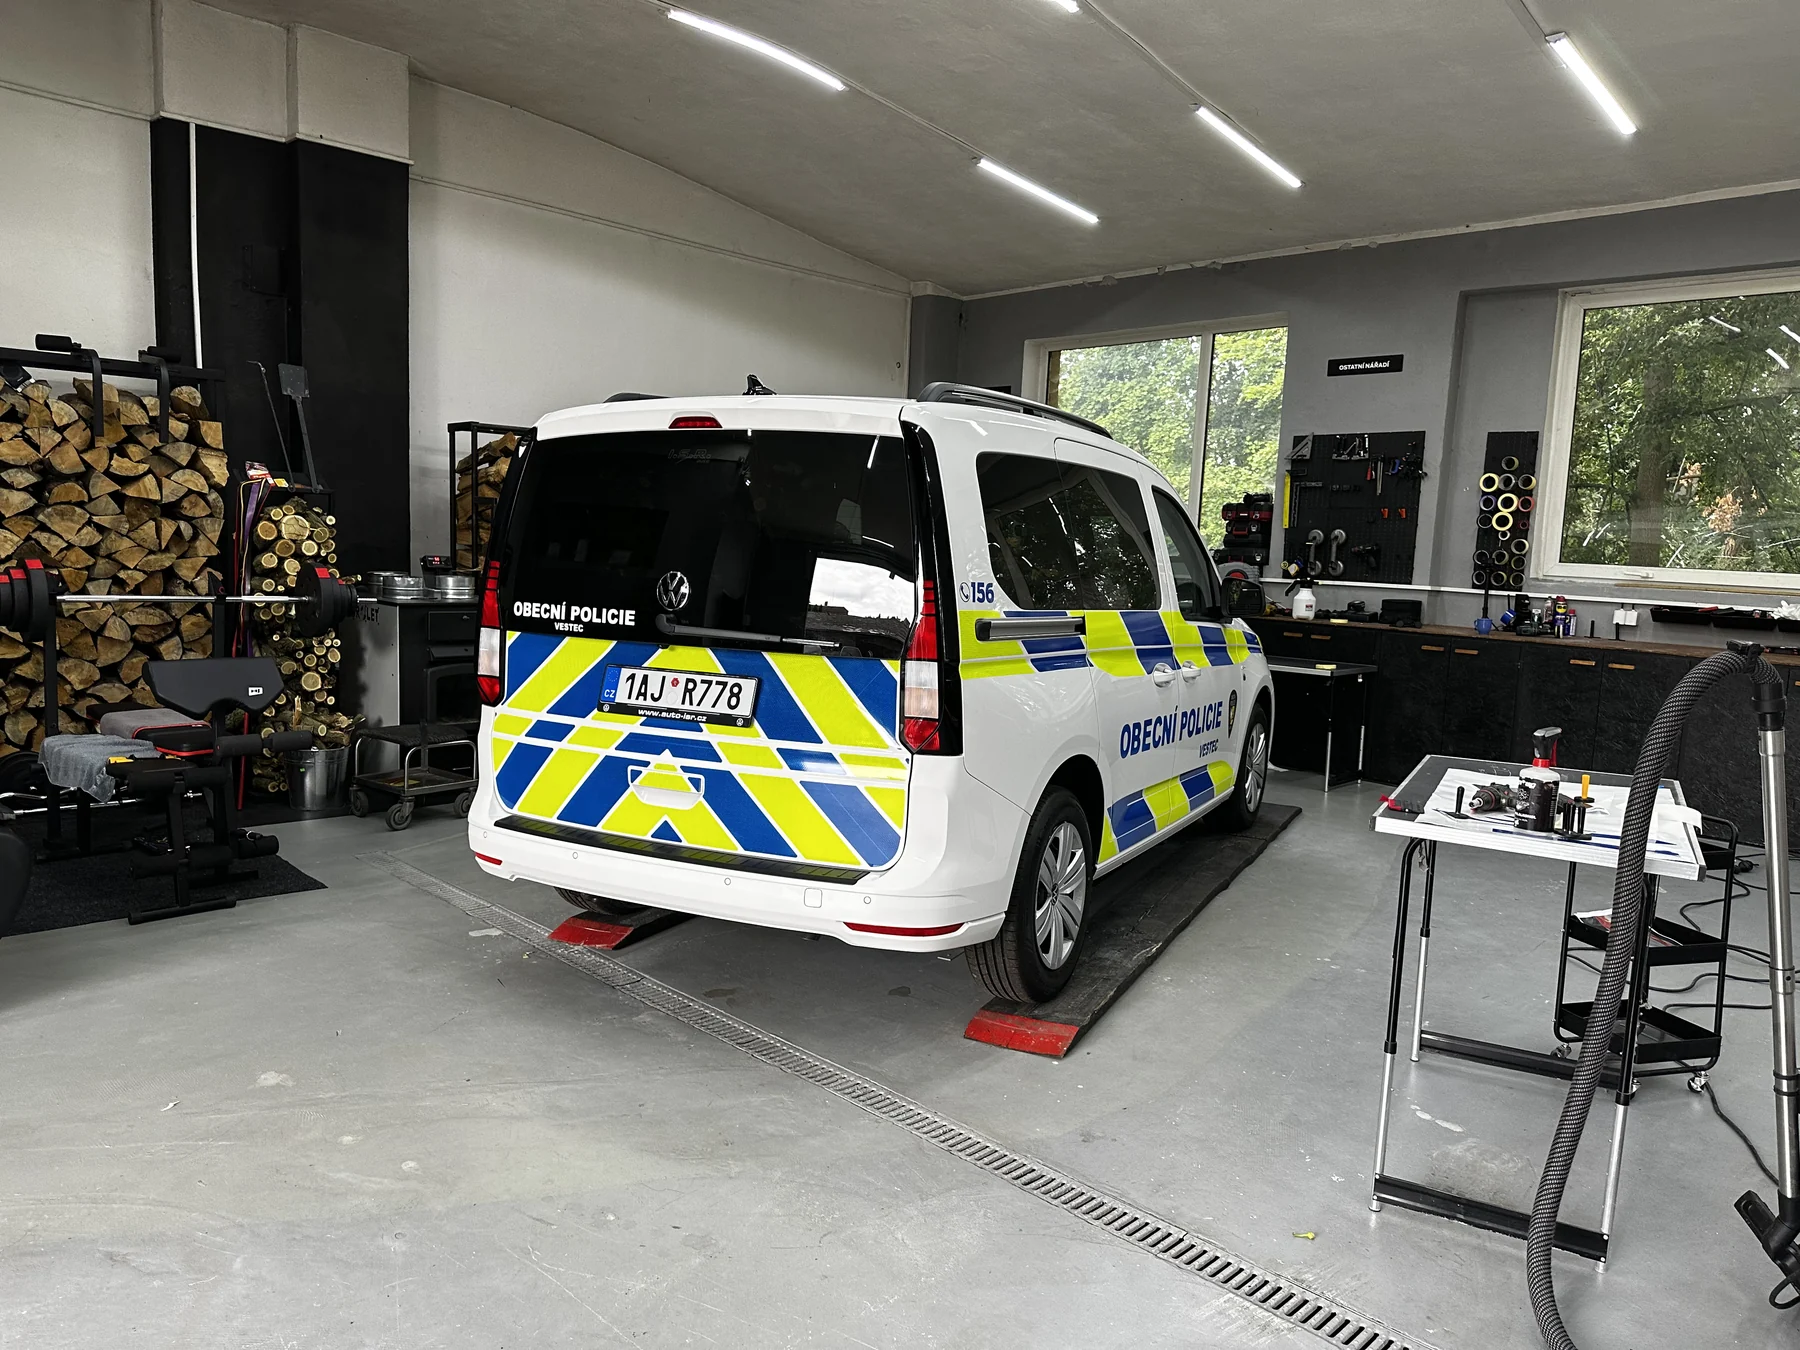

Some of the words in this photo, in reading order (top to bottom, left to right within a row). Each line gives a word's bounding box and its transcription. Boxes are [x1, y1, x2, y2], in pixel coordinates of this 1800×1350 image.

[1339, 362, 1365, 371] OSTATNÍ
[1365, 360, 1390, 369] NÁŘADÍ
[971, 581, 995, 603] 156
[513, 601, 566, 620] OBECNÍ
[570, 605, 636, 626] POLICIE
[554, 622, 584, 632] VESTEC
[604, 689, 616, 698] CZ
[1120, 705, 1178, 759] OBECNÍ
[1179, 701, 1223, 741] POLICIE
[1199, 739, 1219, 758] VESTEC
